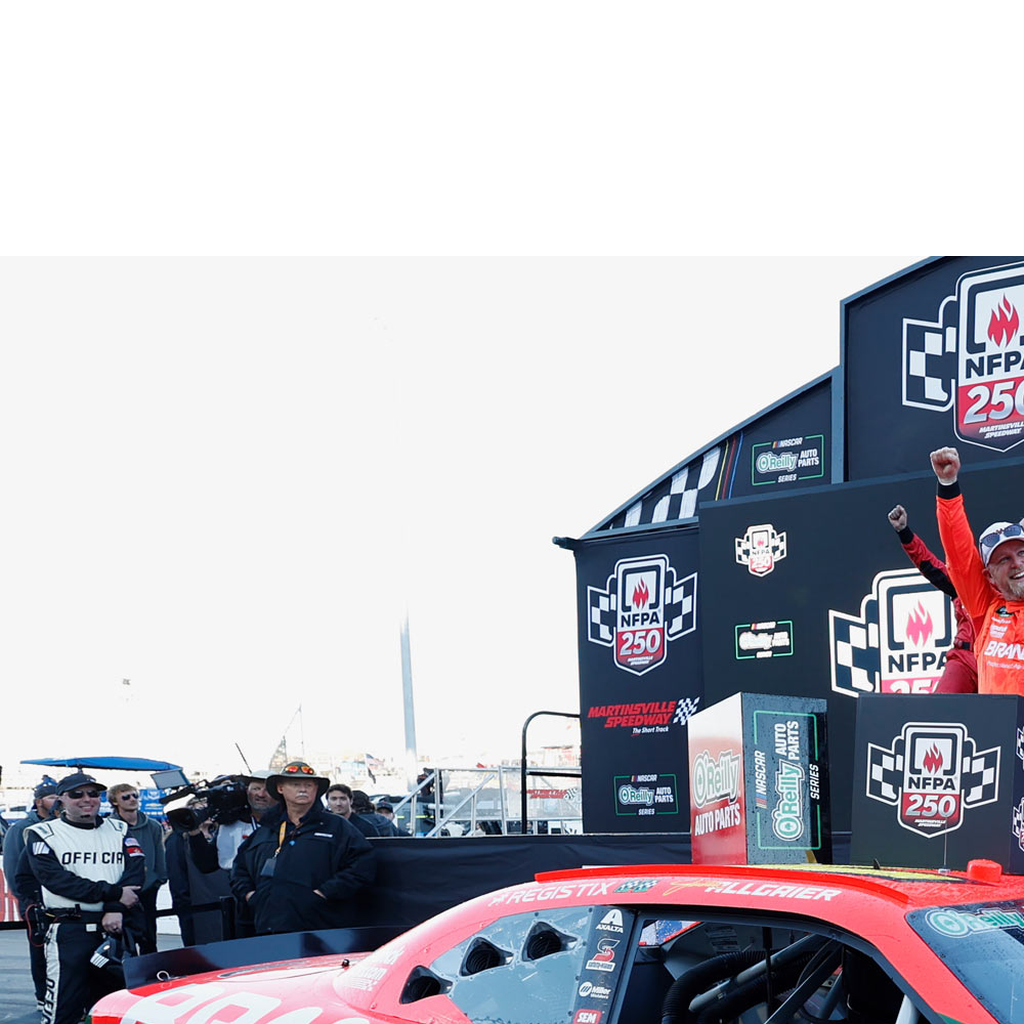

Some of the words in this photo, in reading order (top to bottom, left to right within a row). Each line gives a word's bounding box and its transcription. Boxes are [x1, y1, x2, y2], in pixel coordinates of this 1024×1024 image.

[779, 437, 803, 448] NASCAR
[756, 449, 797, 472] O'Reilly
[800, 449, 818, 459] AUTO
[798, 456, 819, 468] PARTS
[777, 474, 798, 484] SERIES
[621, 613, 660, 628] NFPA
[620, 630, 661, 656] 250
[588, 701, 676, 718] MARTINSVILLE
[604, 714, 672, 728] SPEEDWAY
[775, 723, 787, 755] AUTO
[788, 720, 800, 760] PARTS
[637, 774, 657, 782] NASCAR
[693, 749, 741, 808] O'Reilly
[755, 751, 766, 794] NASCAR
[809, 764, 820, 800] SERIES
[908, 776, 956, 790] NFPA
[618, 785, 654, 805] O'Reilly
[654, 794, 674, 803] PARTS
[656, 787, 671, 796] AUTO
[772, 759, 805, 842] O'Reilly
[905, 795, 957, 817] 250
[638, 808, 655, 816] SERIES
[695, 810, 714, 836] AUTO
[715, 803, 741, 831] PARTS
[61, 851, 123, 865] OFFICIA
[507, 881, 614, 903] REGISTIX
[595, 923, 624, 933] AXALTA
[577, 1012, 597, 1023] SEM
